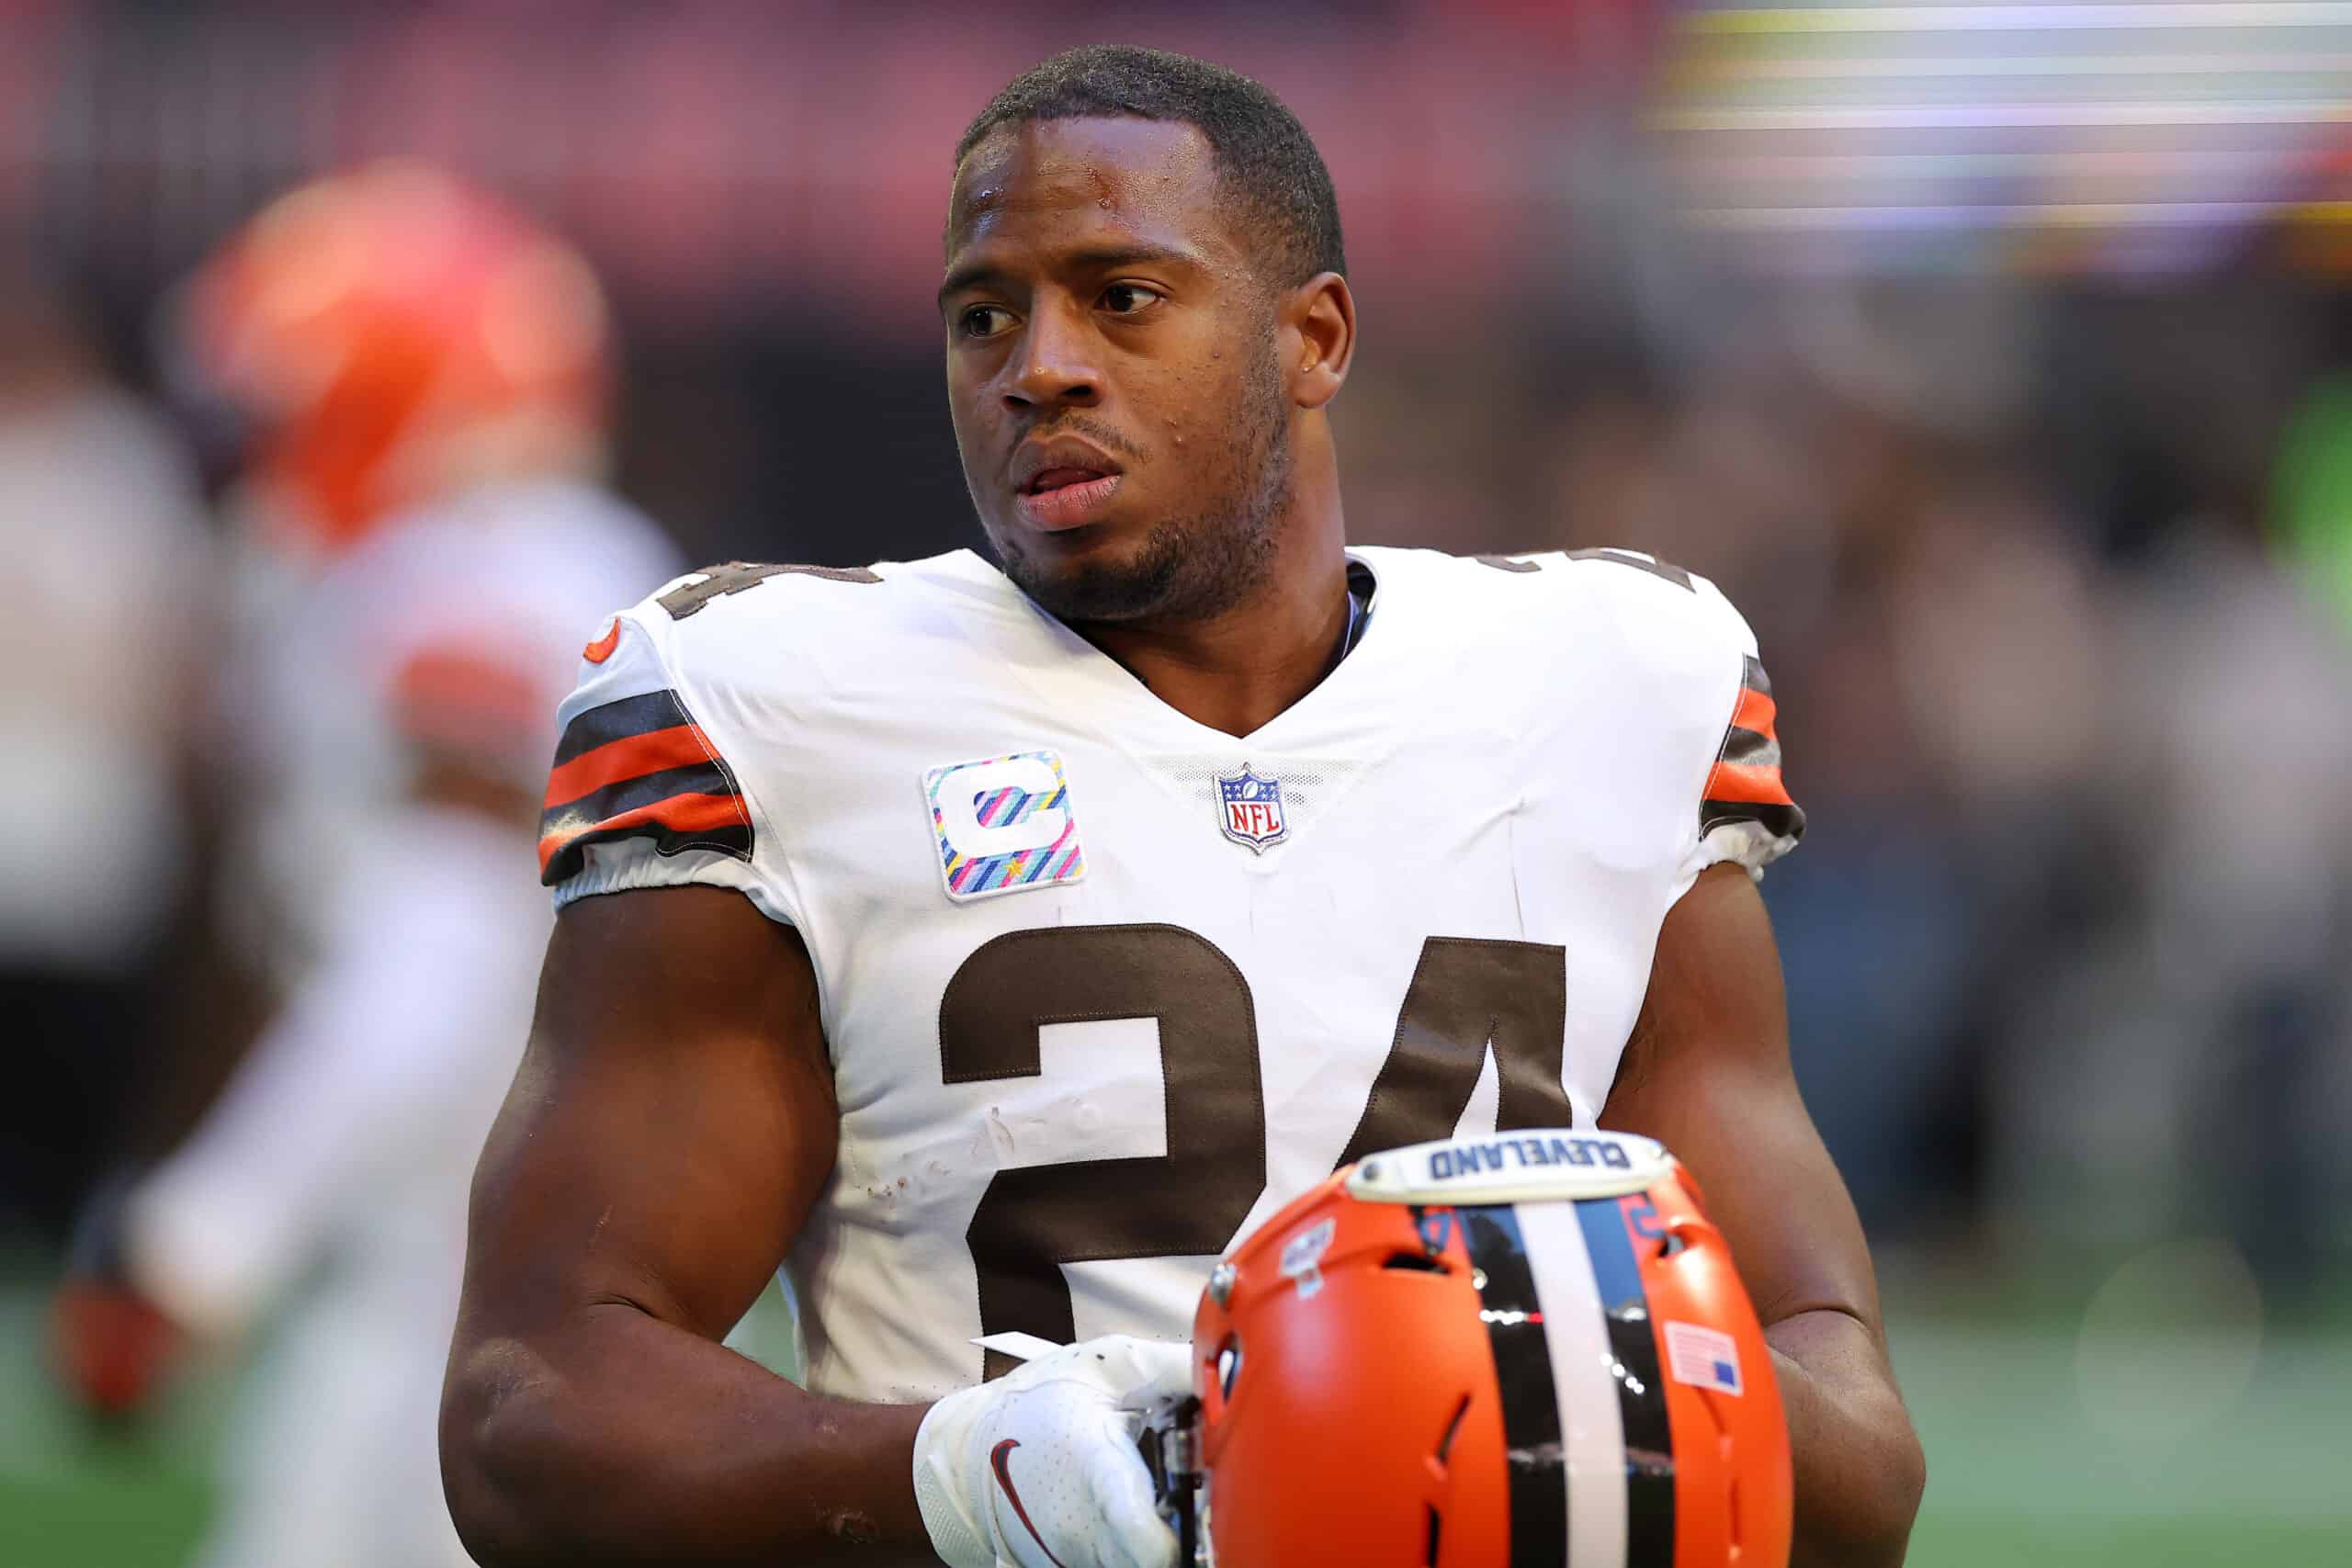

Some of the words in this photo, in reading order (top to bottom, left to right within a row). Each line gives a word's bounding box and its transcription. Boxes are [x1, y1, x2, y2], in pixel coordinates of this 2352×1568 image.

[936, 758, 1068, 859] C
[1229, 803, 1280, 836] NFL
[1430, 1138, 1631, 1180] CLEVELAND
